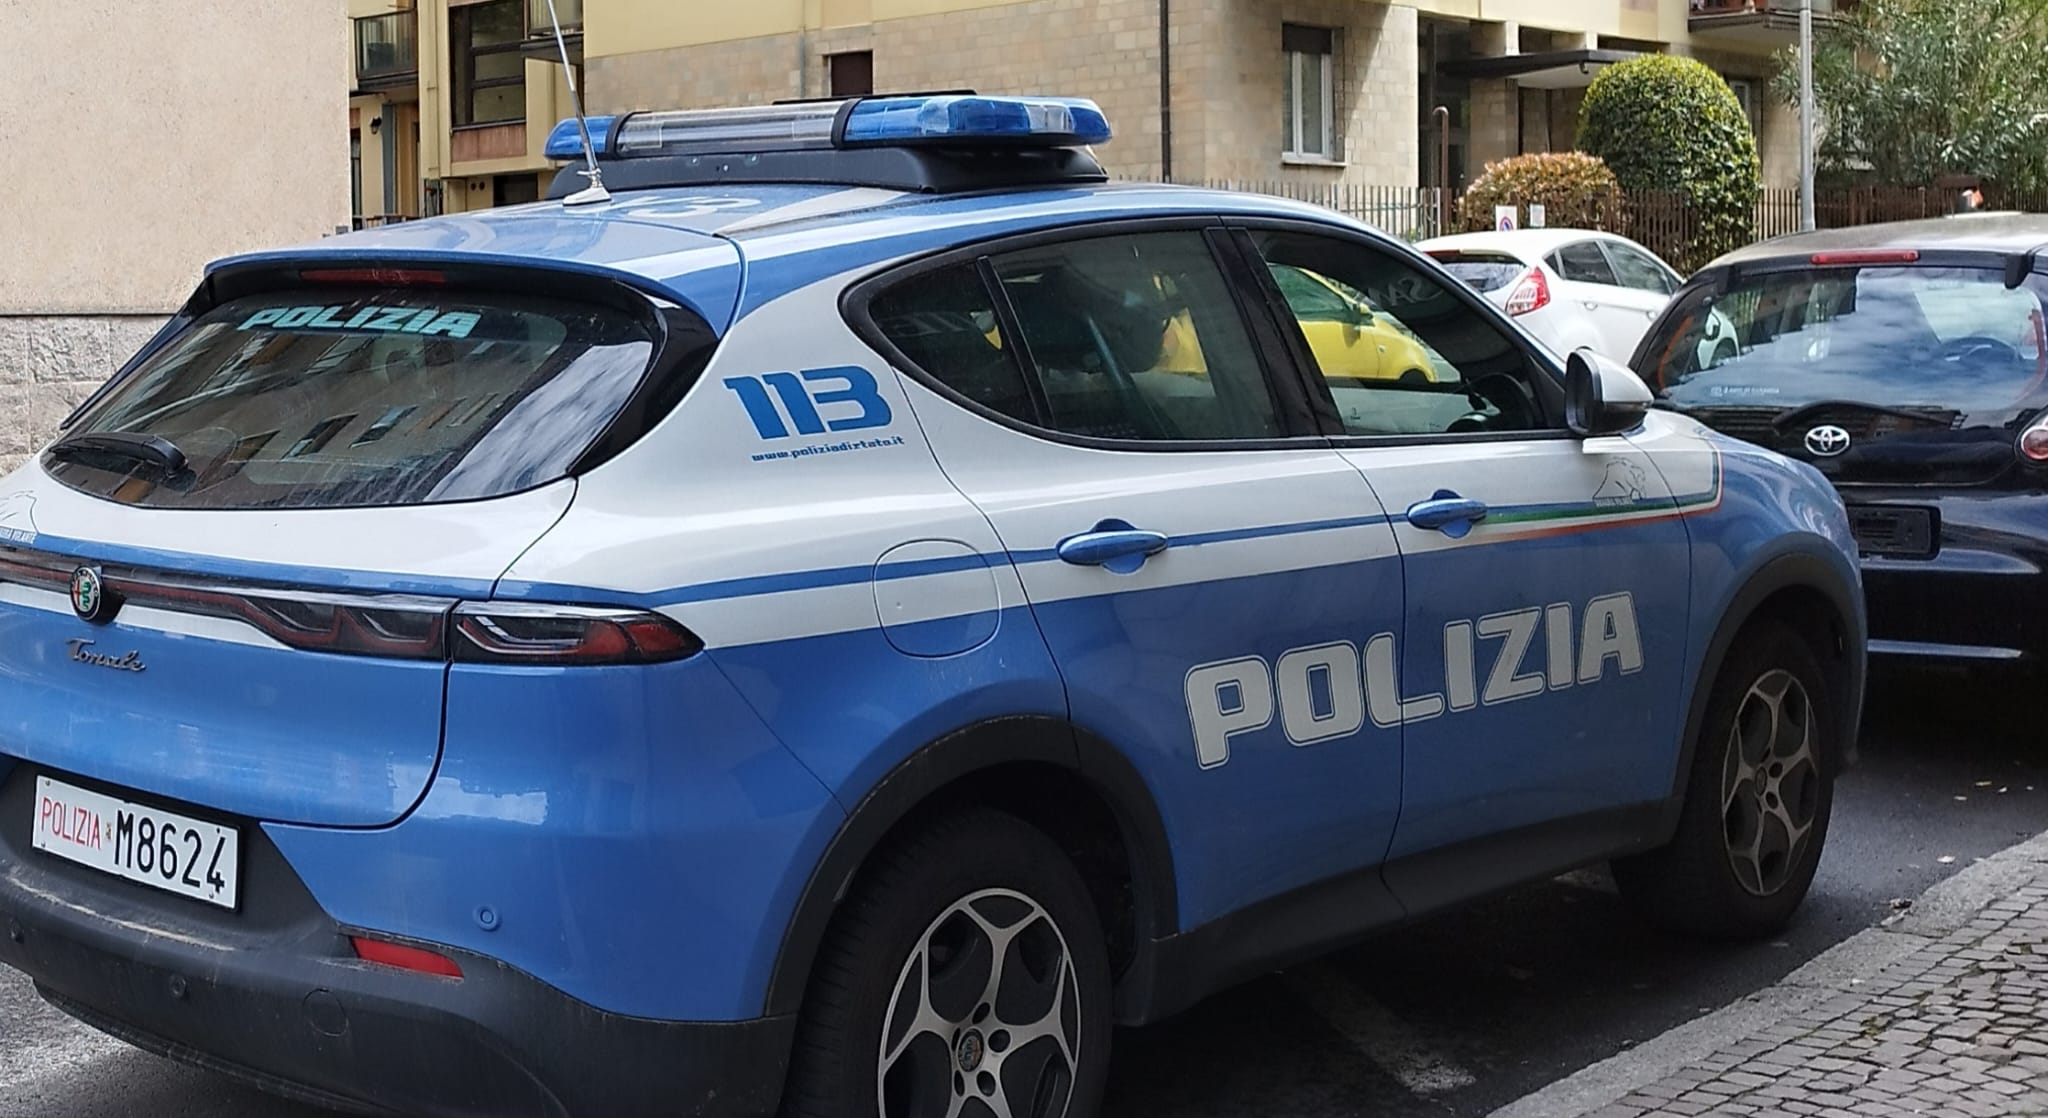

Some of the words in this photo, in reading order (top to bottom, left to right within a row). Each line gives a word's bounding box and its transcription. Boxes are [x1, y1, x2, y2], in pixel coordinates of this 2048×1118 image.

[237, 305, 483, 338] POLIZIA
[722, 364, 893, 440] 113
[66, 637, 146, 671] Tonale
[1183, 590, 1645, 770] POLIZIA
[41, 797, 101, 850] POLIZIA
[114, 810, 227, 893] M8624
